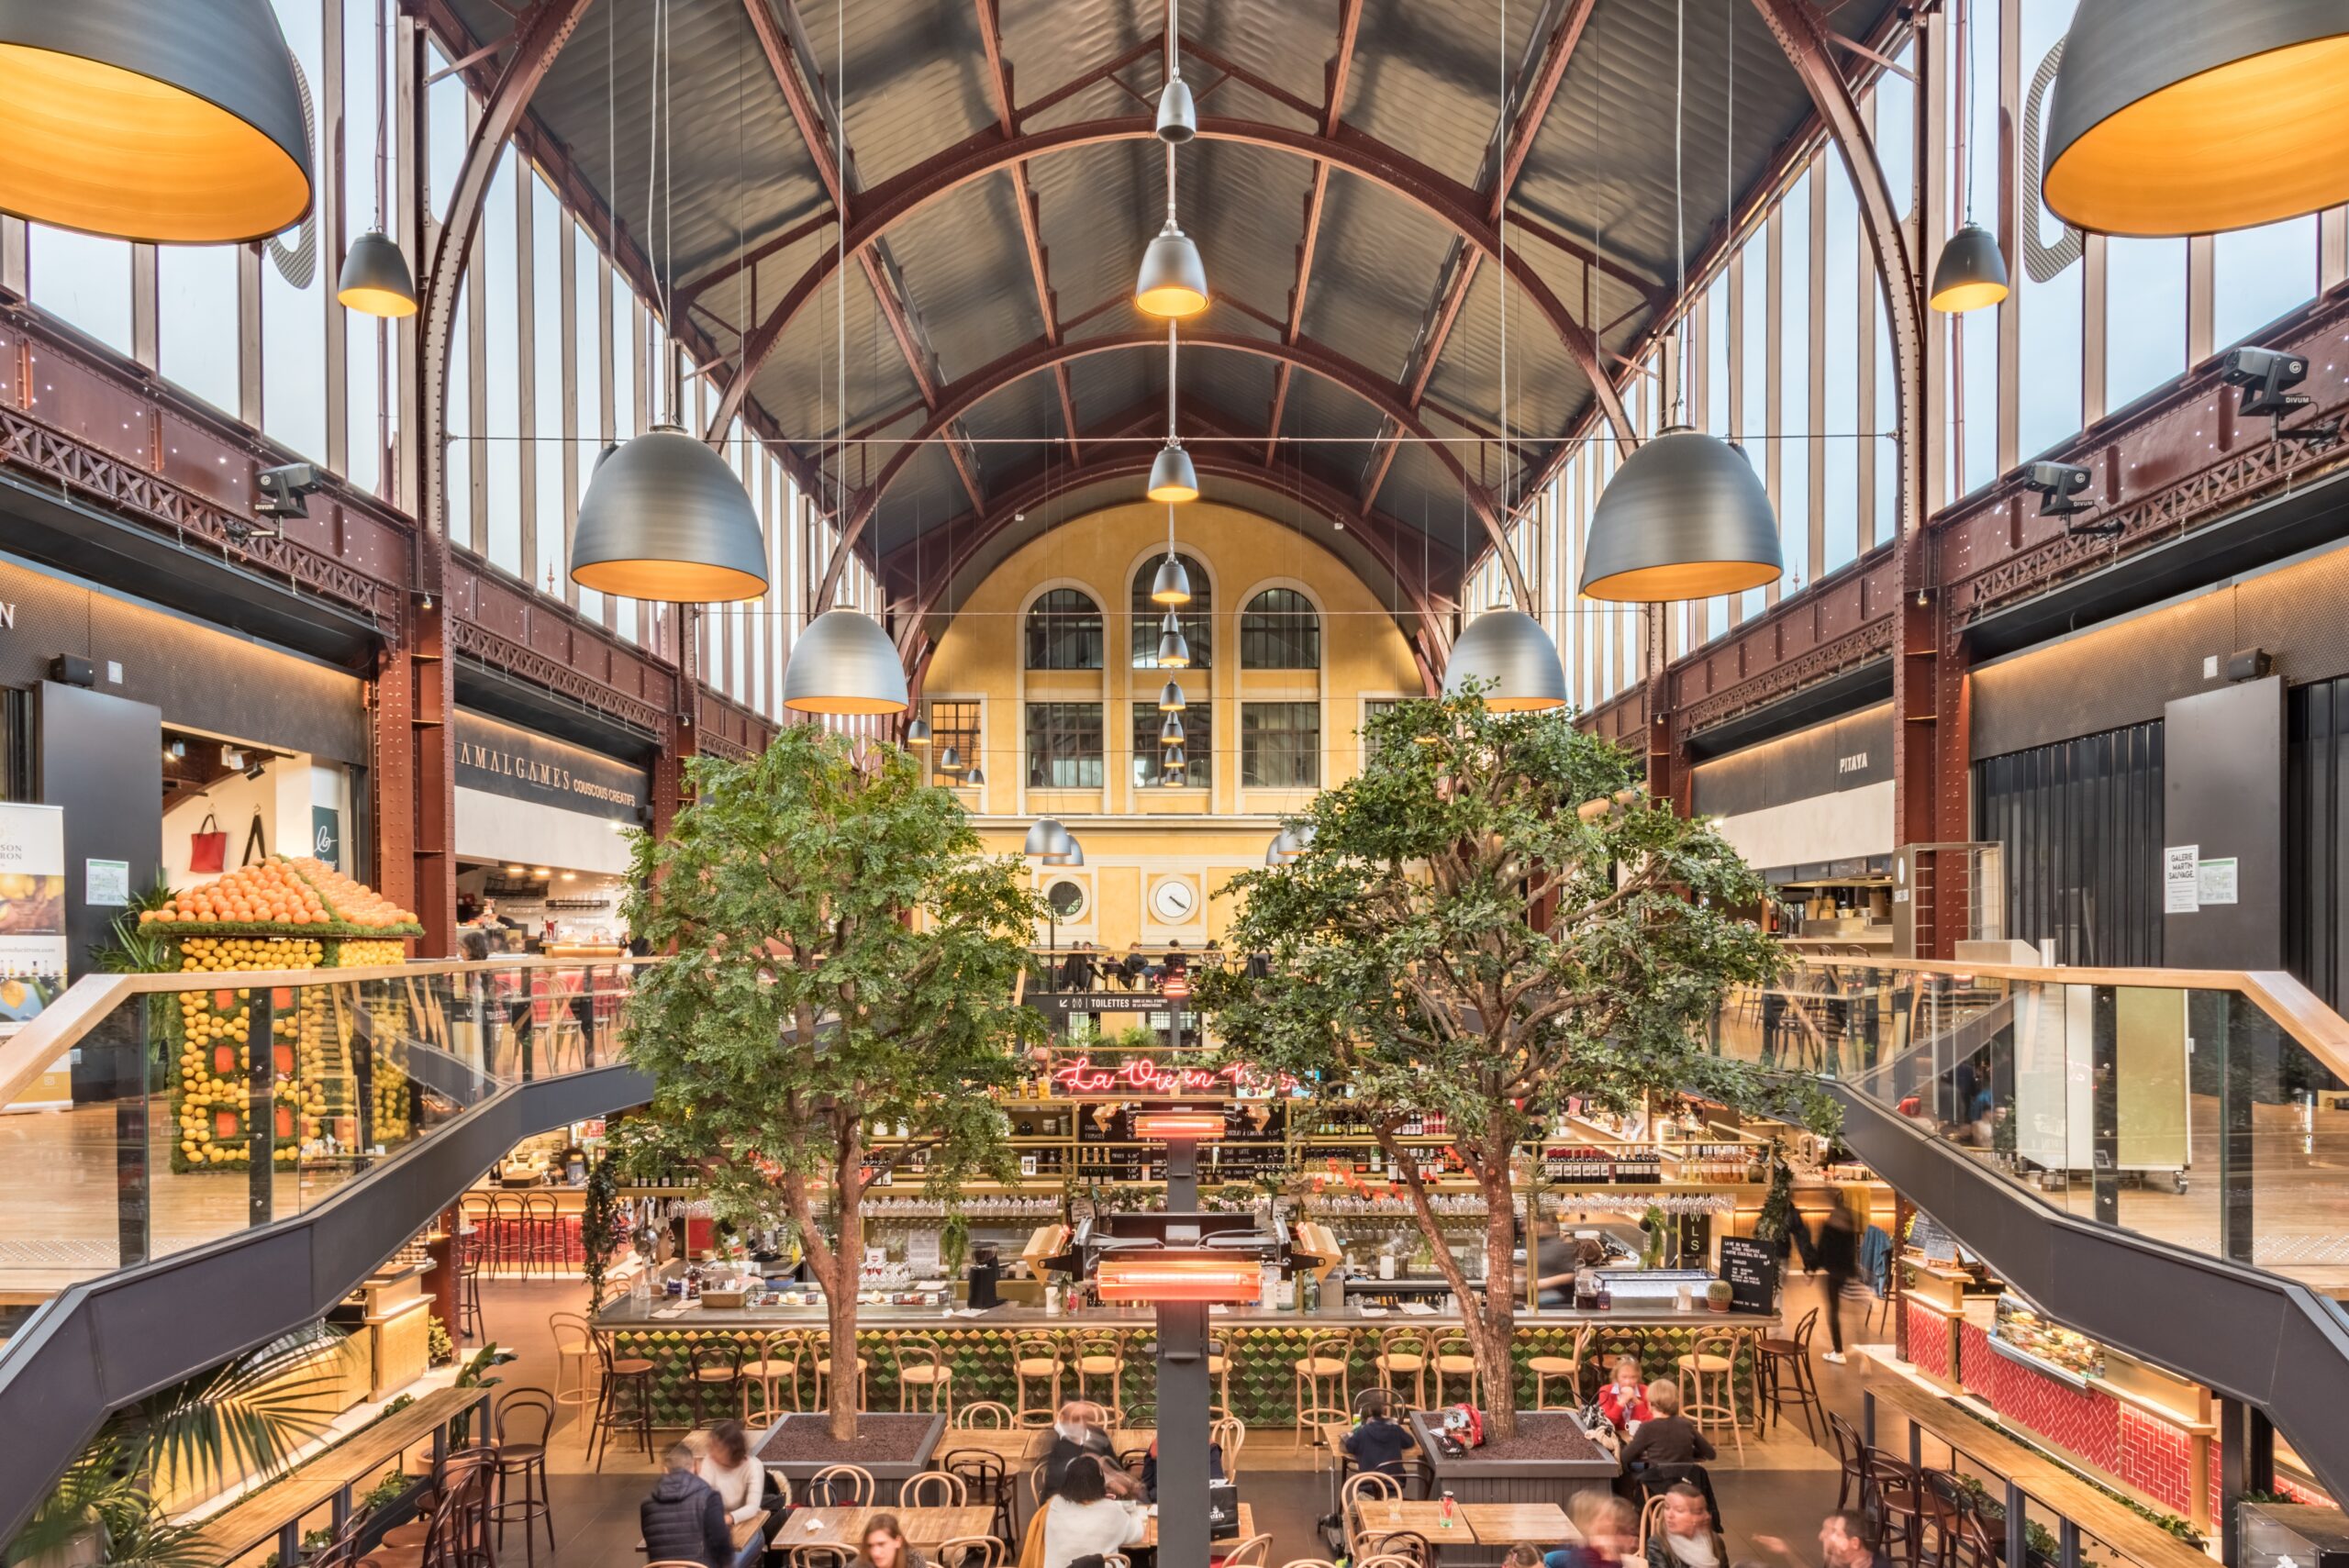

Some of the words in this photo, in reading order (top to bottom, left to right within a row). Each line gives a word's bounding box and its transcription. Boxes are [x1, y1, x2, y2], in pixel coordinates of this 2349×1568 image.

[1840, 751, 1867, 773] PITAYA
[461, 742, 570, 790] AMALGAMES
[573, 779, 608, 800] COUSCOUS
[608, 789, 636, 807] CREATIFS
[2171, 852, 2194, 862] GALERIE
[2173, 862, 2193, 871] MARTIN
[1091, 998, 1130, 1008] TOILETTES
[1055, 1057, 1116, 1090] La
[1118, 1060, 1178, 1091] Vie
[1183, 1070, 1216, 1088] en
